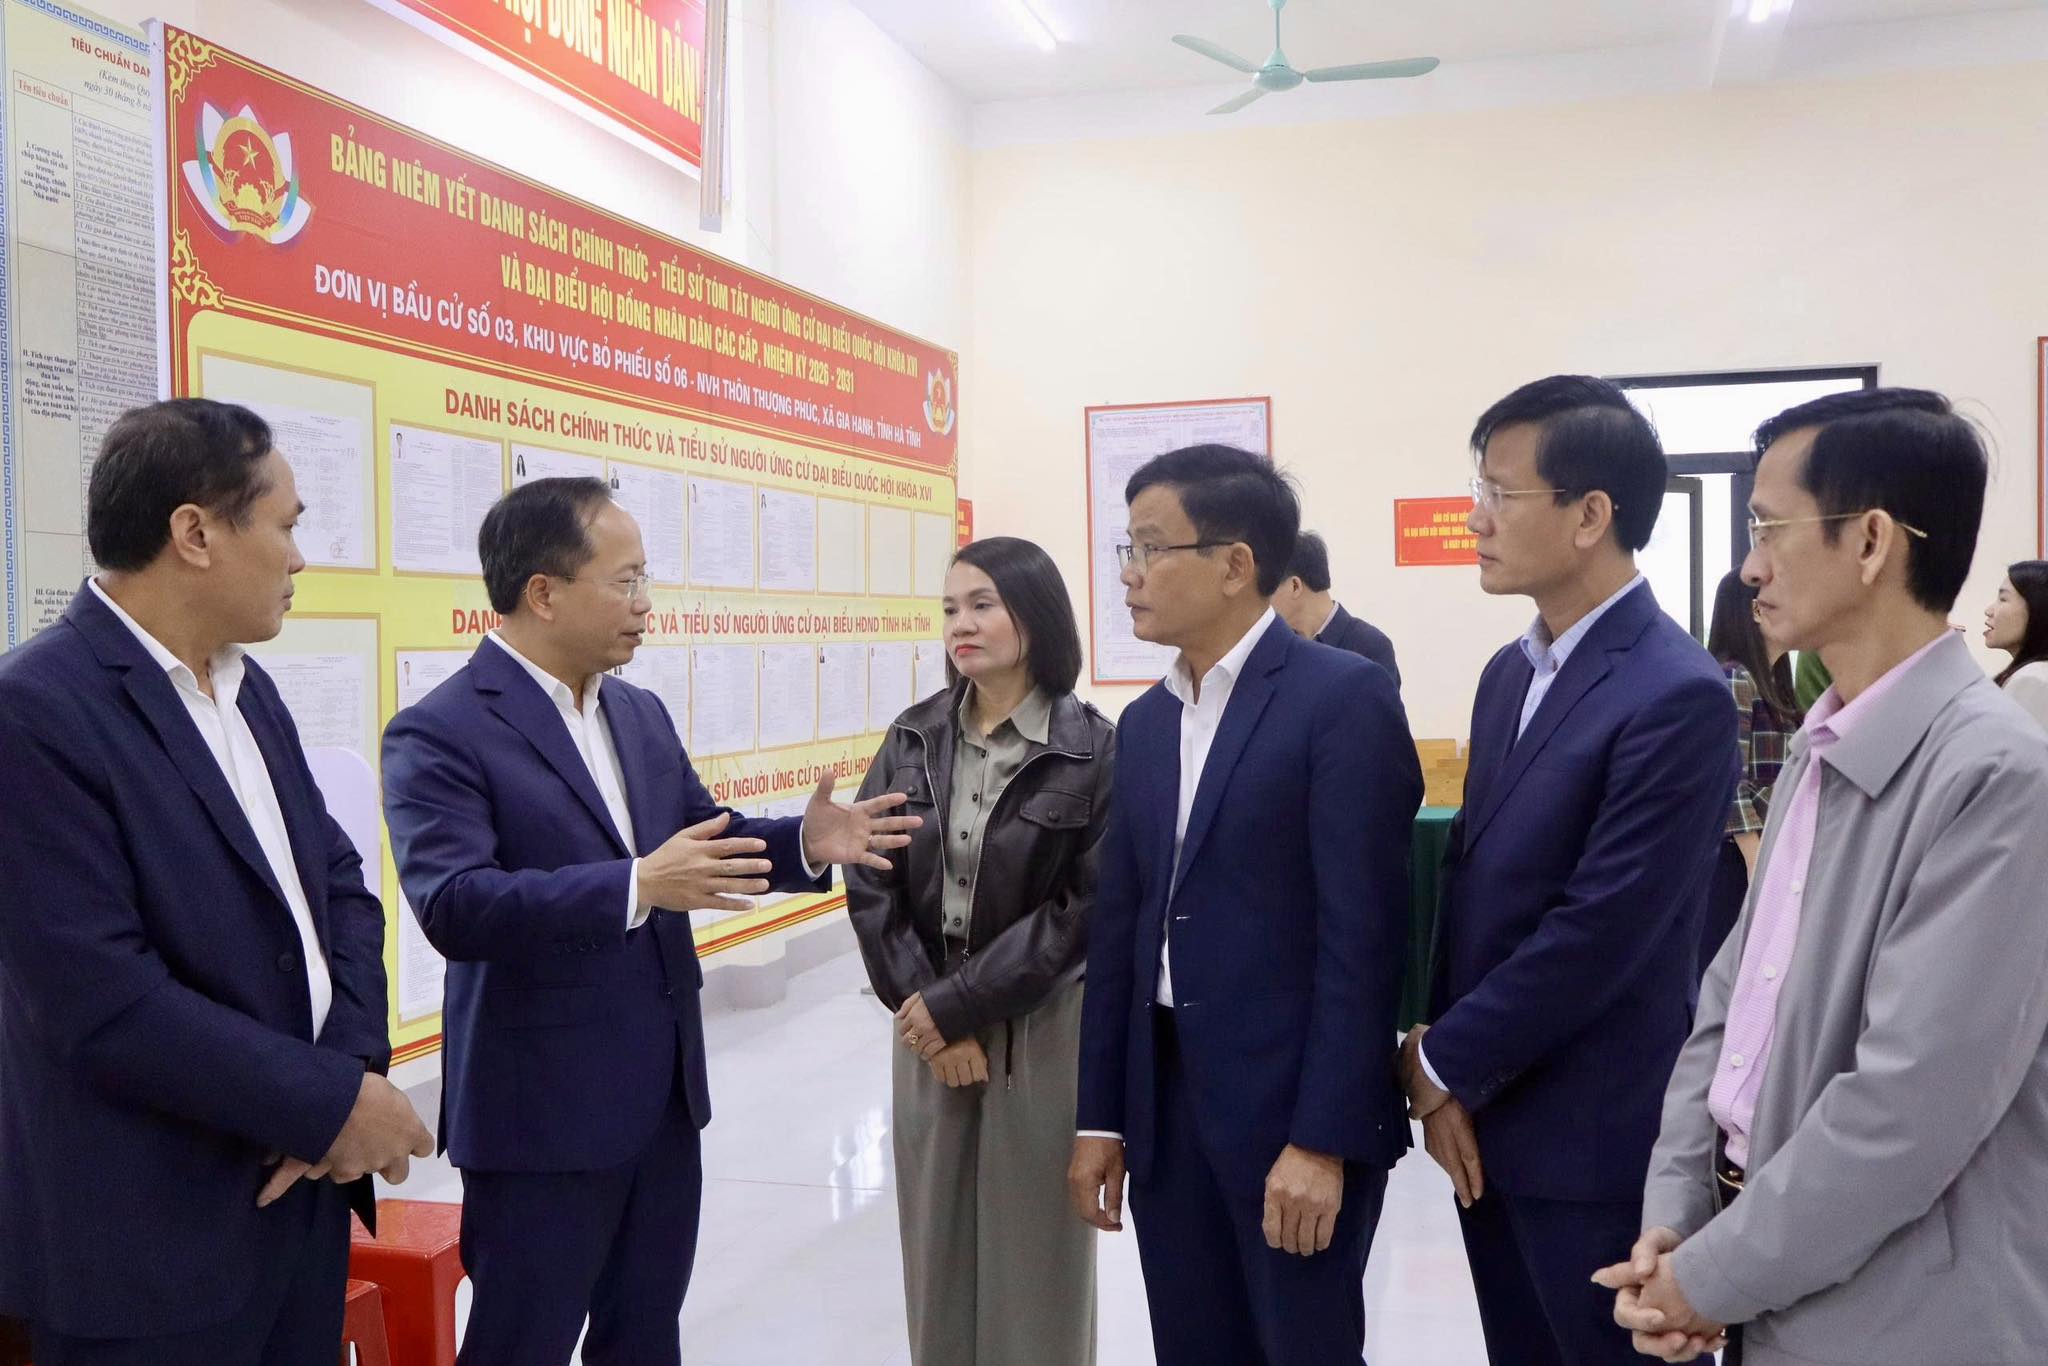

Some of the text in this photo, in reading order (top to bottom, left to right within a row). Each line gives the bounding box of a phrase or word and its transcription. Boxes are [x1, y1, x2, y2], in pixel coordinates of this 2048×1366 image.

[72, 37, 91, 54] TIÊU
[94, 50, 130, 70] CHUẨN
[331, 124, 386, 189] BẢNG
[392, 158, 440, 208] NIÊM
[446, 173, 476, 221] YẾT
[480, 192, 524, 240] DANH
[528, 209, 568, 254] SÁCH
[572, 228, 614, 271] CHÍNH
[617, 244, 648, 284] THỨC
[660, 254, 684, 296] TIỂU
[688, 264, 704, 302] SỬ
[706, 276, 728, 312] TÓM
[731, 282, 748, 318] TẮT
[752, 296, 780, 330] NGƯỜI
[782, 302, 800, 337] ỨNG
[803, 308, 815, 342] CỬ
[816, 322, 831, 351] ĐẠI
[833, 321, 850, 354] BIỂU
[852, 330, 872, 362] QUỐC
[874, 340, 886, 370] HỘI
[888, 346, 906, 374] KHÓA
[906, 353, 918, 378] XVI
[315, 264, 361, 303] ĐƠN
[368, 278, 387, 318] VỊ
[393, 280, 432, 322] BẦU
[438, 292, 464, 330] CỬ
[468, 301, 491, 336] SỐ
[495, 316, 519, 348] 03,
[523, 324, 554, 354] KHU
[559, 332, 588, 368] VỰC
[592, 336, 610, 368] BỎ
[614, 346, 650, 380] PHIẾU
[655, 354, 672, 384] SỐ
[674, 366, 688, 388] 06
[697, 372, 720, 398] NVH
[722, 378, 750, 406] THÔN
[753, 387, 792, 419] THƯỢNG
[794, 398, 820, 425] PHÚC,
[822, 404, 834, 426] XÃ
[836, 412, 850, 430] GIA
[852, 416, 876, 439] HANH,
[877, 416, 892, 440] TỈNH
[894, 423, 904, 444] HÀ
[906, 426, 921, 448] TĨNH
[500, 252, 522, 292] VÀ
[526, 262, 550, 306] ĐẠI
[555, 266, 586, 312] BIỂU
[591, 282, 613, 325] HỘI
[616, 288, 650, 332] ĐỒNG
[654, 306, 686, 342] NHÂN
[690, 316, 712, 350] DÂN
[715, 324, 736, 358] CÁC
[764, 343, 793, 379] NHIỆM
[796, 350, 807, 380] KỲ
[808, 359, 829, 386] 2026
[836, 367, 854, 394] 2031
[446, 388, 932, 502] DANH SÁCH CHÍNH THỨC VÀ TIỂU SỬ NGƯỜI ỨNG CỬ ĐẠI BIỂU QUỐC HỘI KHÓA XVI
[660, 608, 678, 634] VÀ
[682, 602, 710, 634] TIỂU
[714, 606, 730, 634] SỬ
[733, 608, 768, 634] NGƯỜI
[772, 606, 794, 634] ỨNG
[798, 608, 813, 634] CỬ
[814, 615, 831, 640] ĐẠI
[834, 606, 852, 634] BIỂU
[856, 616, 880, 633] HĐND
[881, 610, 900, 633] TỈNH
[902, 610, 912, 632] HÀ
[914, 612, 930, 632] TĨNH
[714, 773, 732, 802] SỬ
[734, 770, 768, 800] NGƯỜI
[772, 768, 794, 792] ỨNG
[798, 760, 812, 786] CỬ
[833, 750, 852, 778] BIỂU
[855, 756, 875, 774] HĐN
